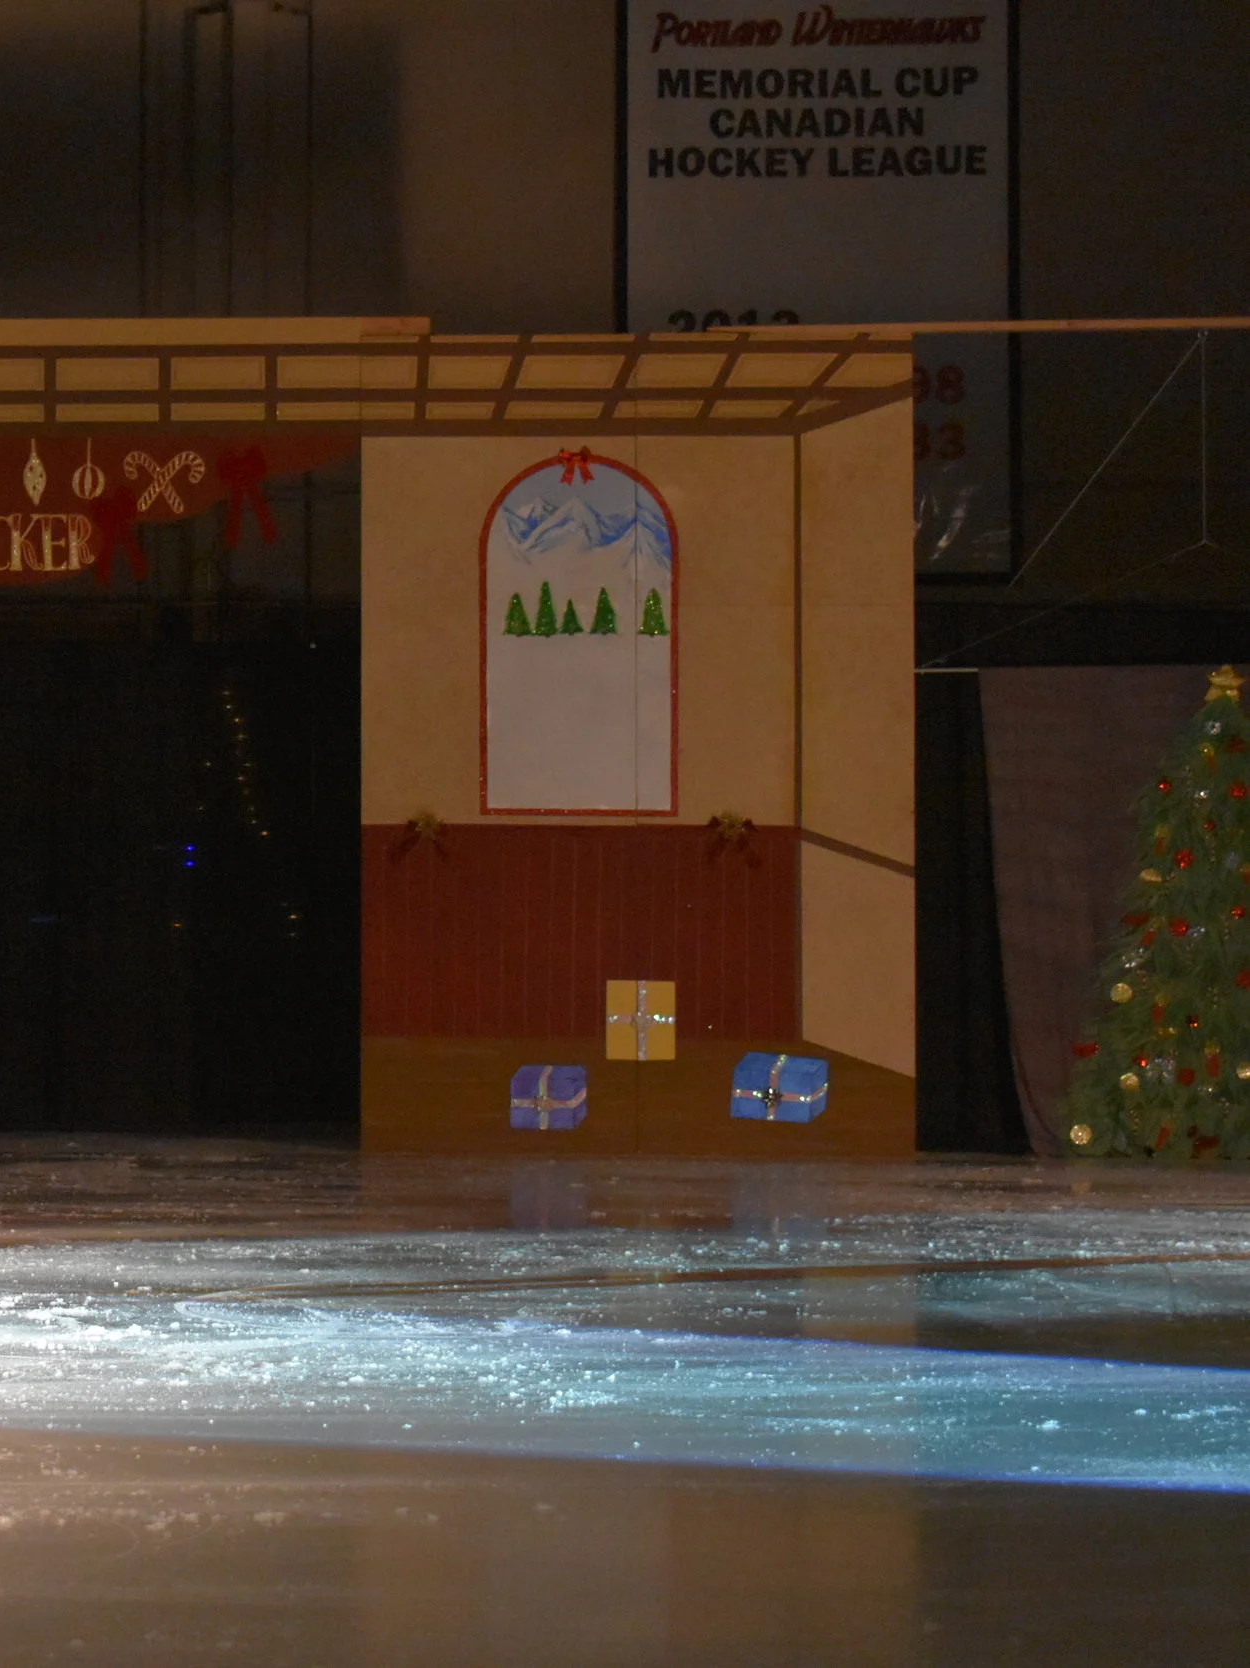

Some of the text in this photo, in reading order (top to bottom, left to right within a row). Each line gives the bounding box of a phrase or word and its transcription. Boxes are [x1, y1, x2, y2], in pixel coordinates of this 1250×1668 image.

[657, 66, 979, 99] MEMORIAL CUP
[710, 106, 924, 138] CANADIAN
[648, 145, 987, 178] HOCKEY LEAGUE
